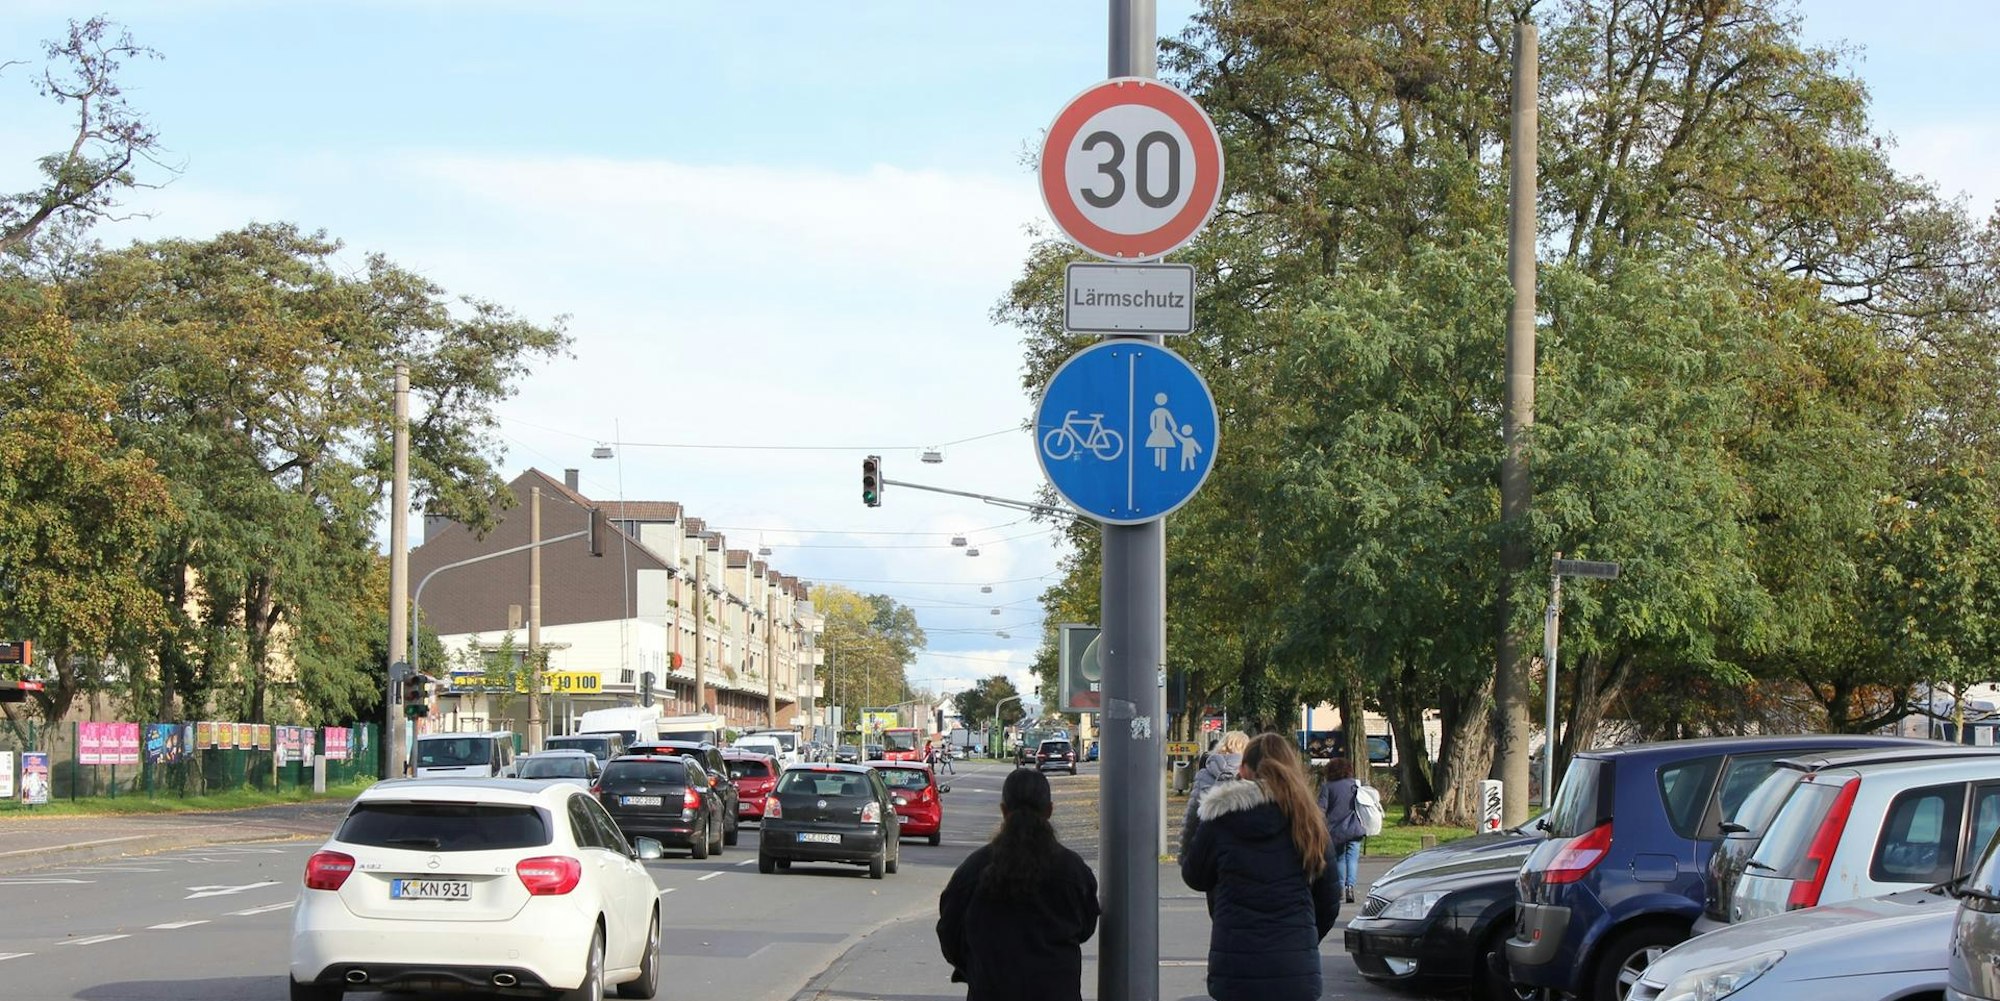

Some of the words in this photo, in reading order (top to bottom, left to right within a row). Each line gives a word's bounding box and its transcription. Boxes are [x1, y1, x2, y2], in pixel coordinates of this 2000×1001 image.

[1080, 130, 1181, 209] 30
[1073, 288, 1185, 309] Lärmschutz
[576, 675, 597, 689] 100
[401, 881, 412, 896] K
[419, 882, 439, 896] KN
[442, 882, 469, 897] 931
